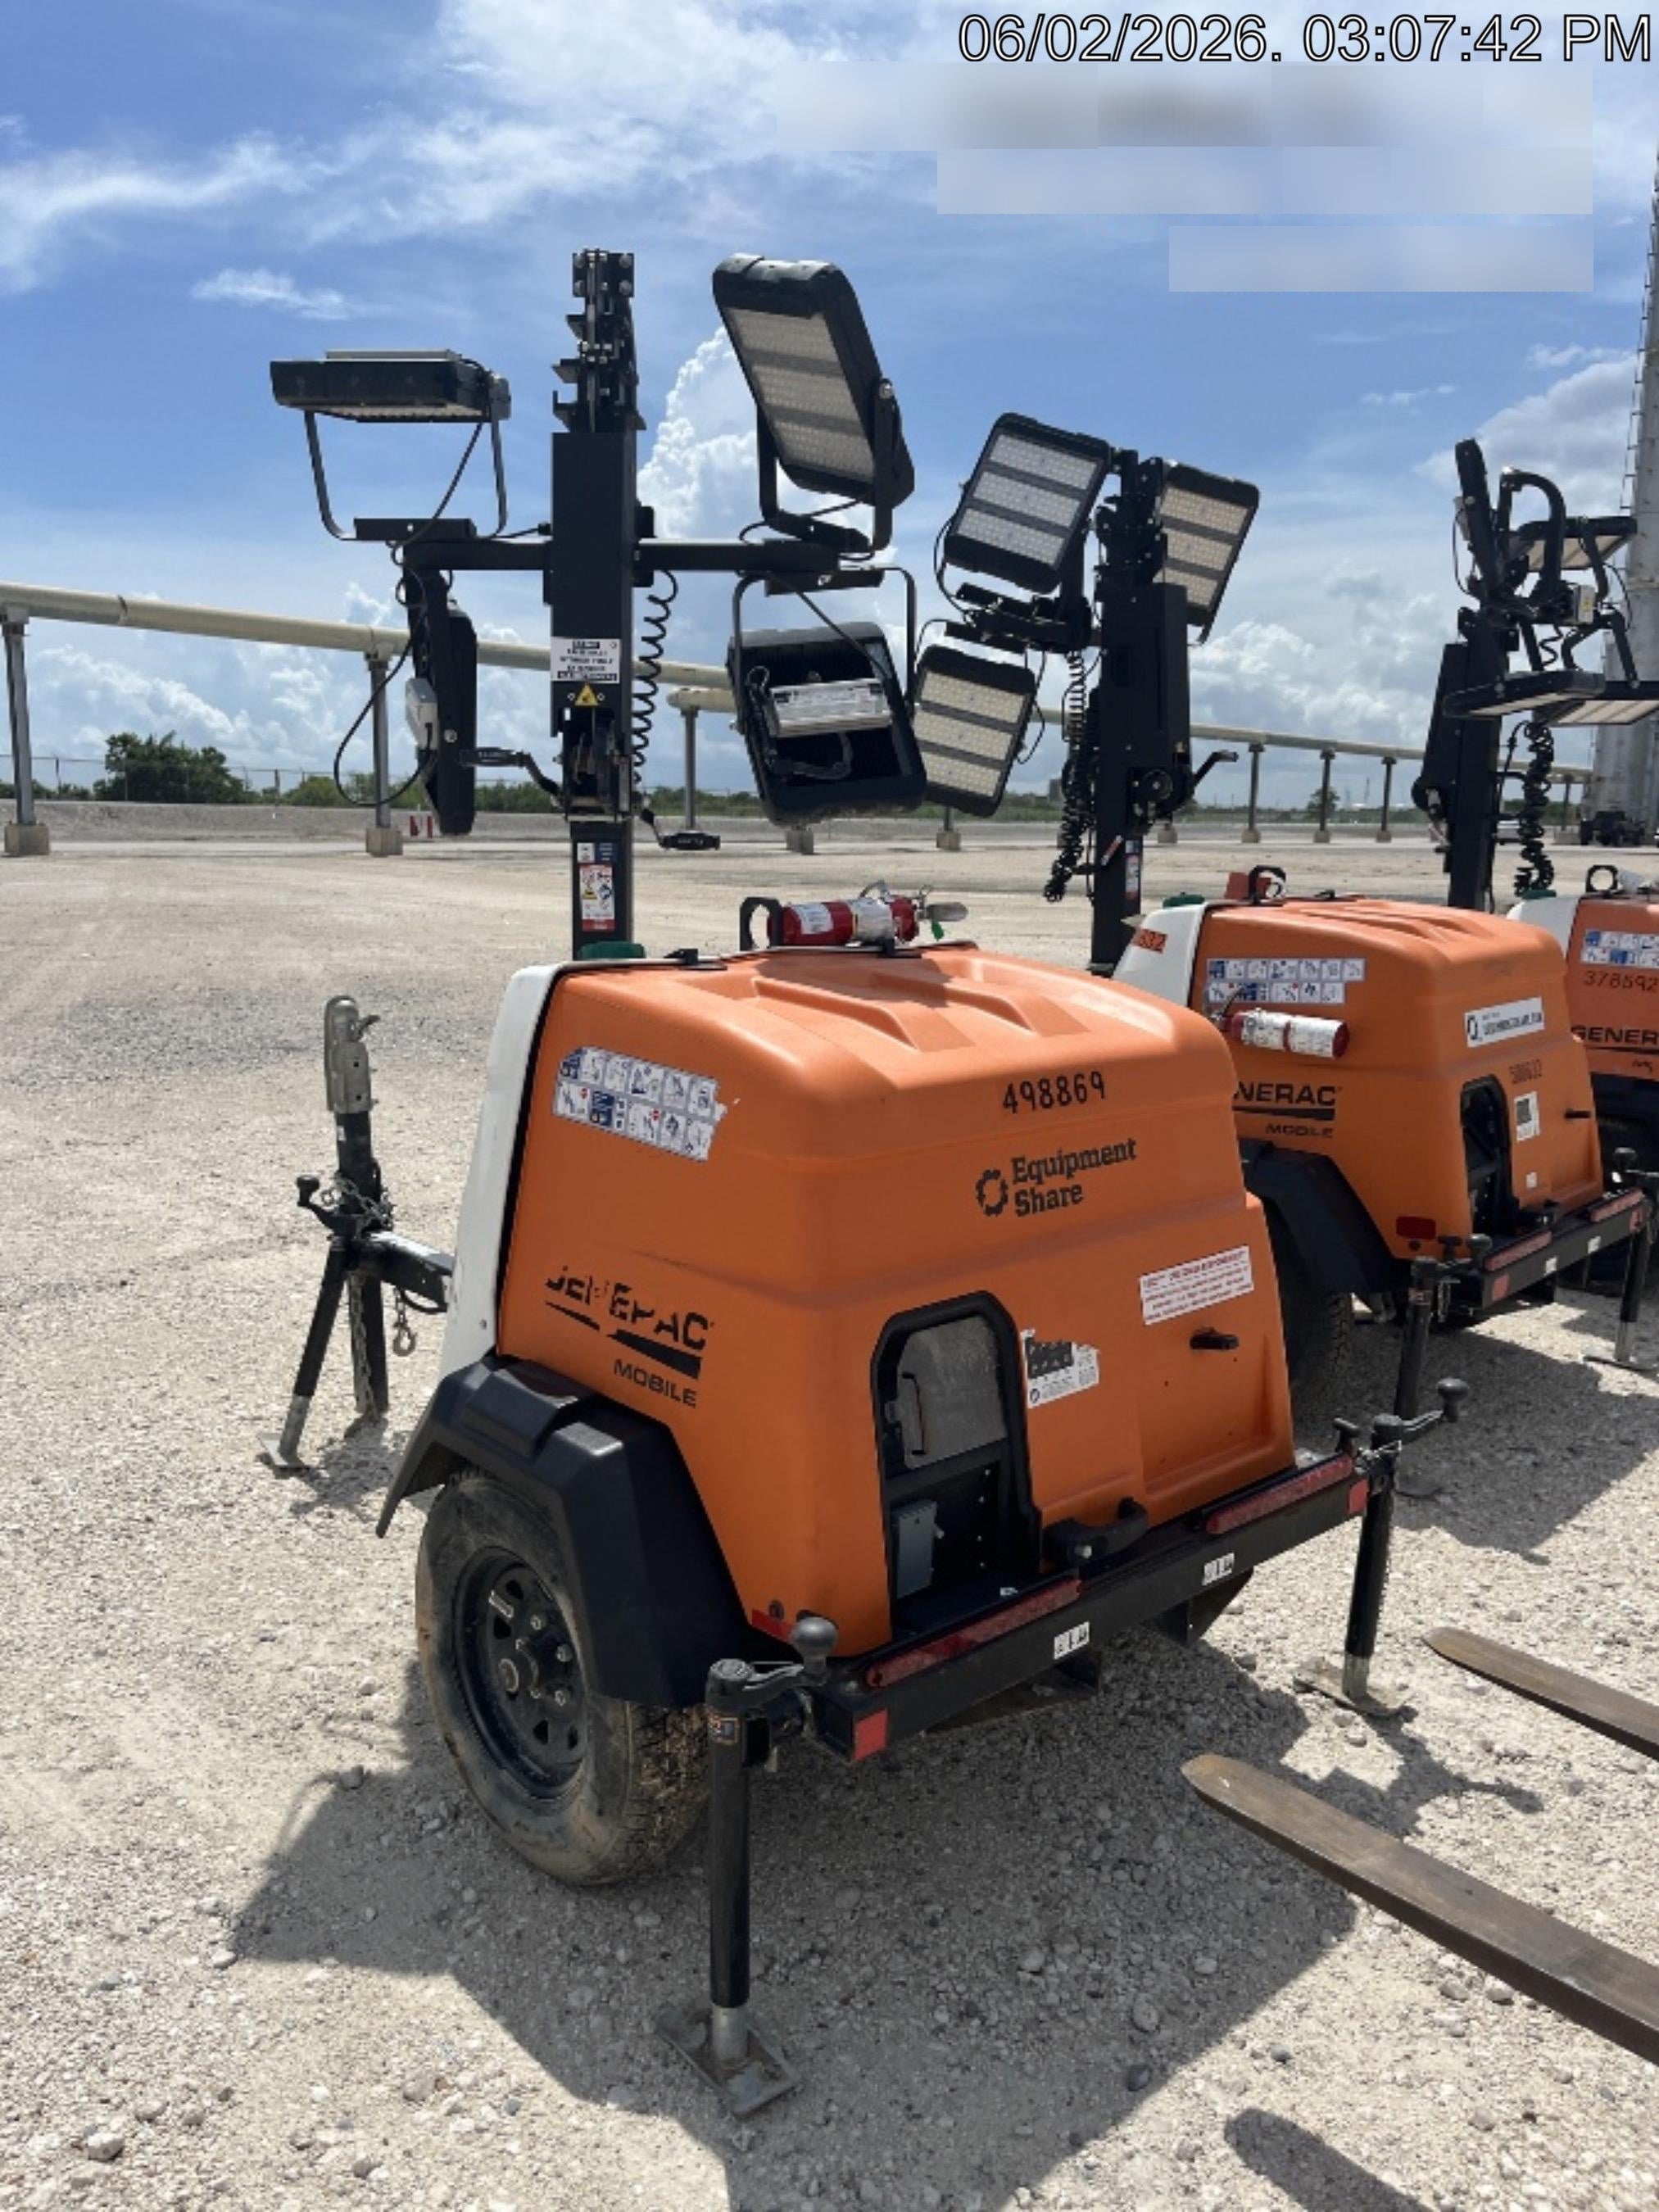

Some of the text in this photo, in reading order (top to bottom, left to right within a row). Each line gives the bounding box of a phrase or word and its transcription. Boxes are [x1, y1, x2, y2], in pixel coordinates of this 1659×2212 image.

[1571, 1024, 1659, 1045] GENER
[1003, 1071, 1105, 1114] 498869
[1233, 1081, 1336, 1106] NERAC
[1011, 1138, 1137, 1185] Equipment
[1014, 1184, 1084, 1217] Share
[613, 1358, 698, 1409] MOBILE
